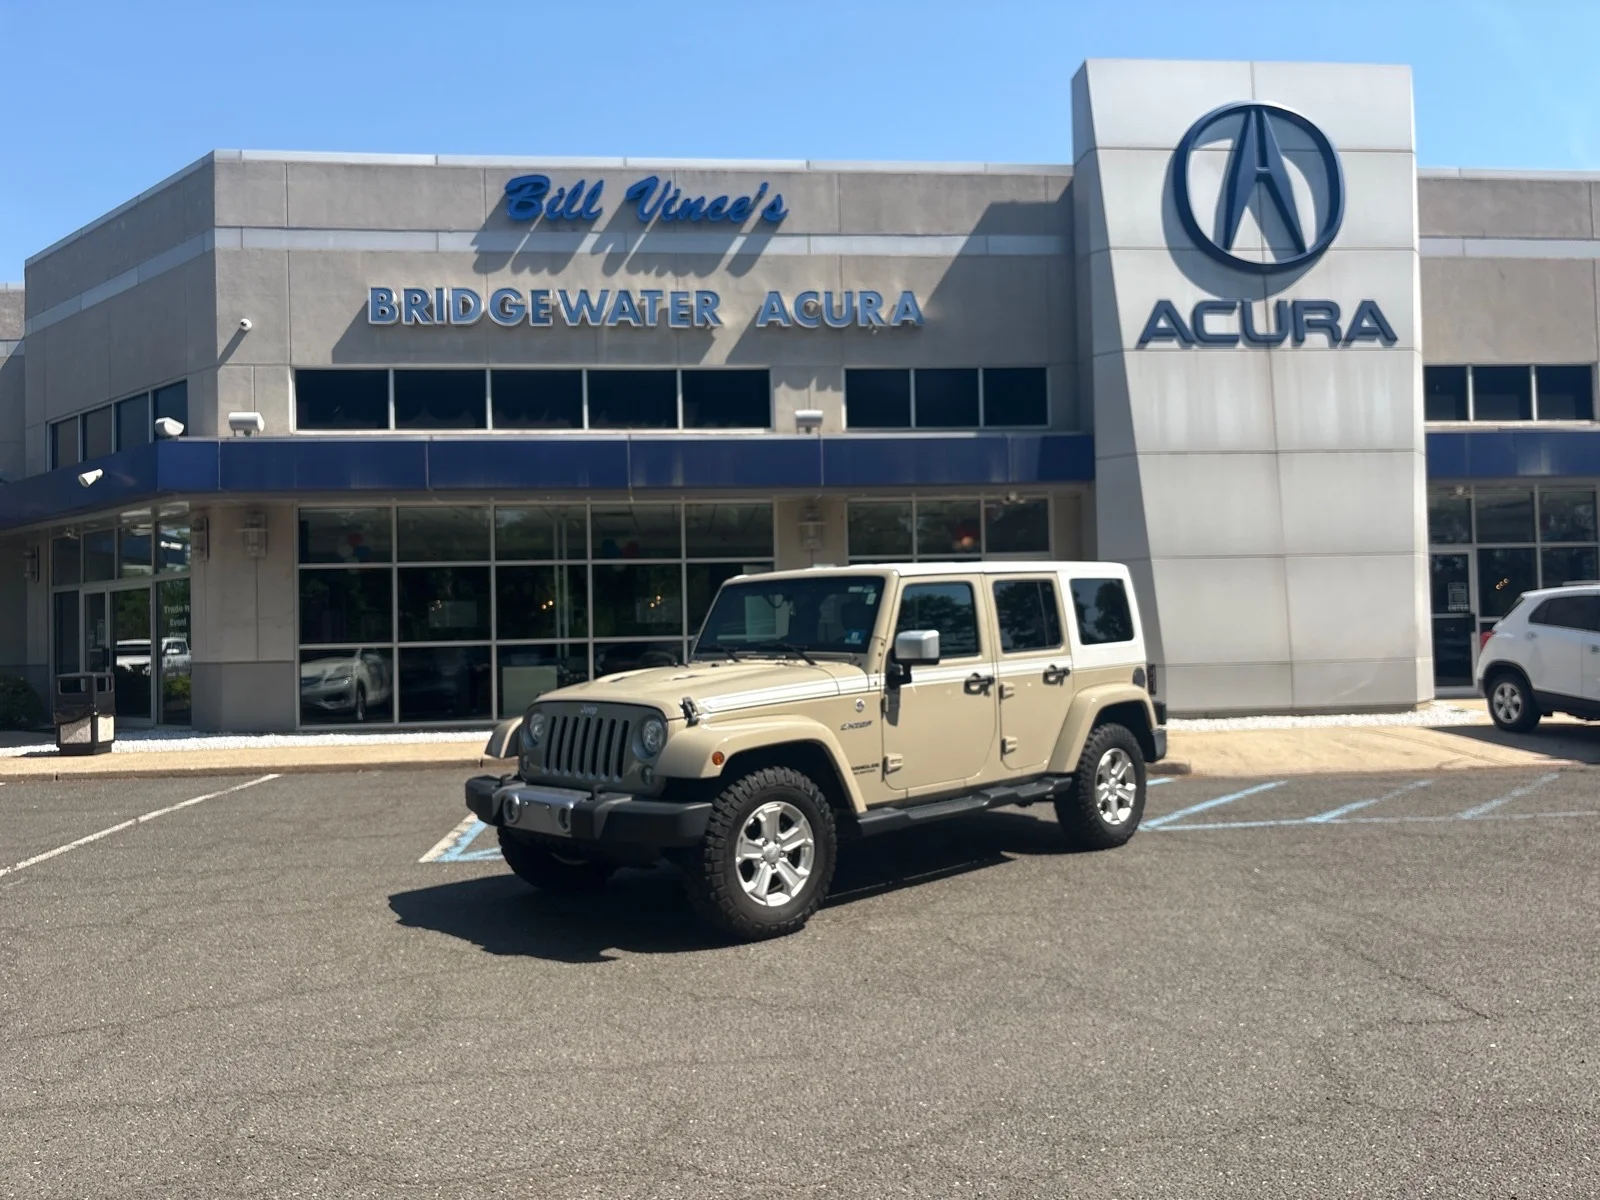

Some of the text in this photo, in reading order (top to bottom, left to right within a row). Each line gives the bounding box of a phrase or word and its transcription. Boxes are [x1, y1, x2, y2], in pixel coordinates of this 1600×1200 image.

[504, 174, 790, 223] Bill Vince's
[367, 286, 926, 330] BRIDGEWATER ACURA
[1136, 299, 1398, 349] ACURA
